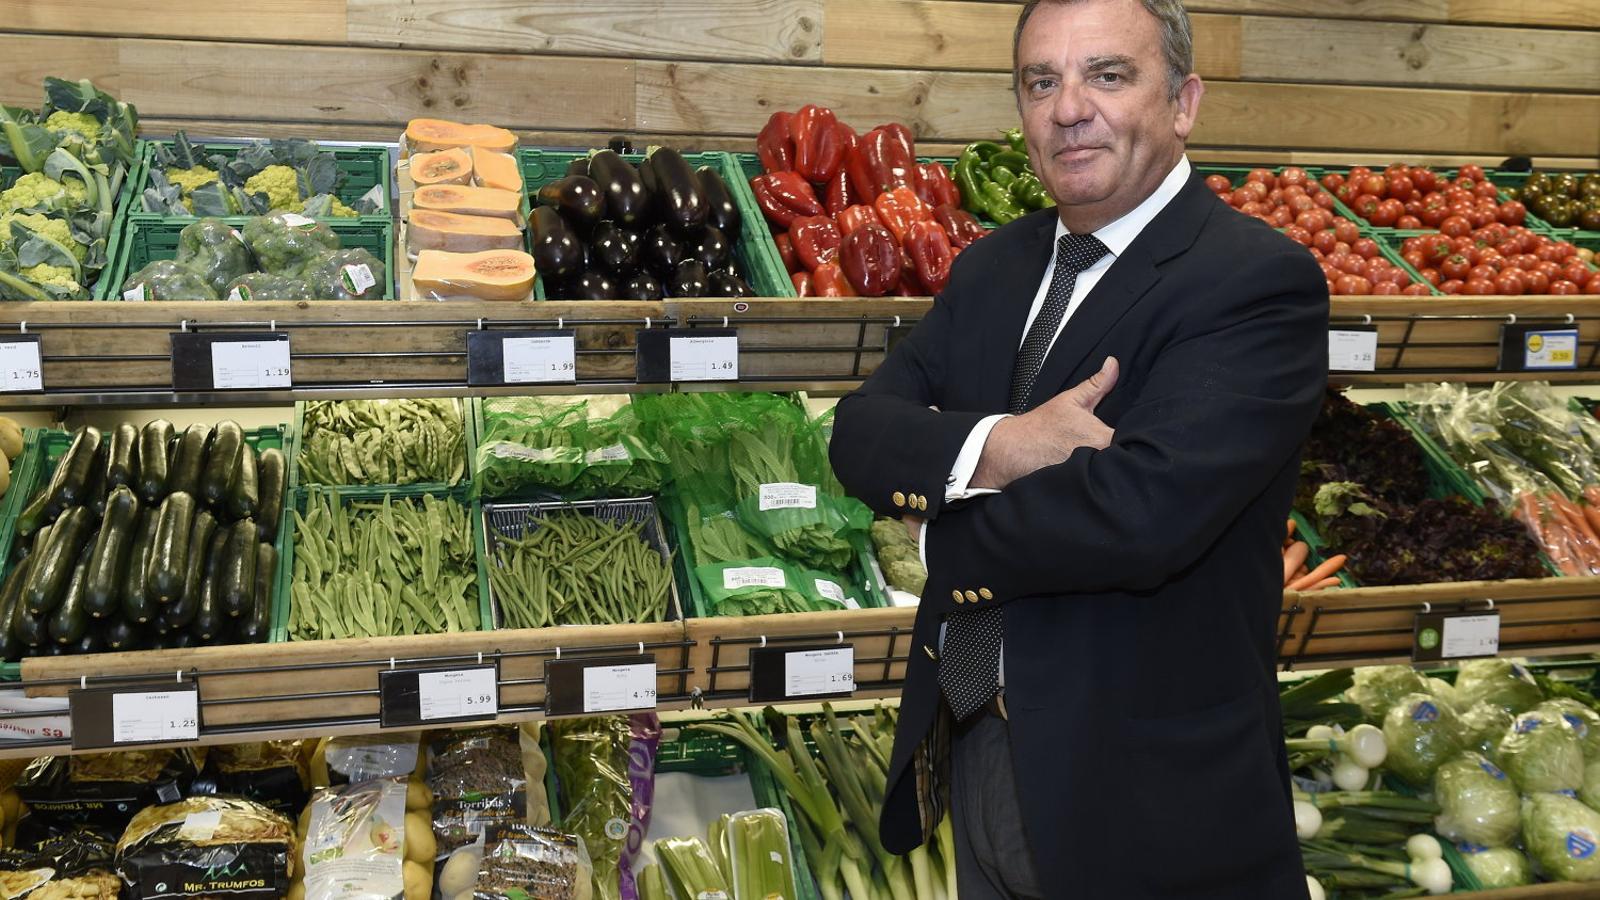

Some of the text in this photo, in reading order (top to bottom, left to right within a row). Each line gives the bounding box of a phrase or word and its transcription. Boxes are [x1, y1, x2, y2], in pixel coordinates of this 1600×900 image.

[551, 362, 574, 371] 1.99
[711, 361, 733, 370] 1.49
[13, 370, 39, 379] 1.75
[265, 368, 289, 377] 1.19
[831, 674, 853, 683] 1.69
[633, 690, 656, 699] 4.79
[467, 695, 491, 705] 5.99
[170, 719, 196, 729] 1.25
[209, 879, 266, 890] TRUMFOS
